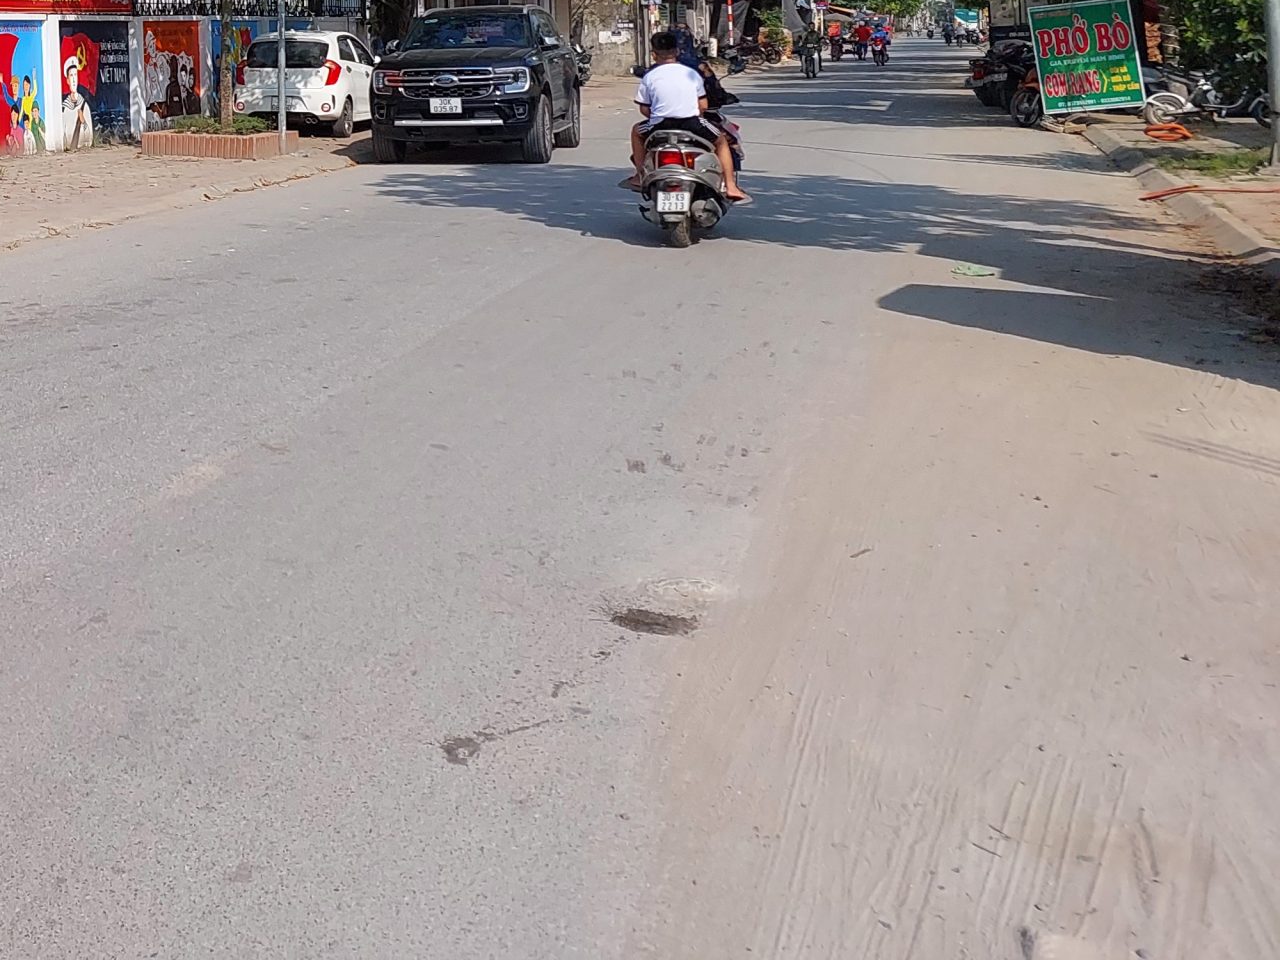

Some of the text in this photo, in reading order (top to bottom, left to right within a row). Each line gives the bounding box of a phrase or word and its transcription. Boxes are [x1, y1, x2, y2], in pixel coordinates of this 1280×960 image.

[1036, 12, 1131, 59] PHỞ BÒ
[100, 65, 127, 86] VIỆT NAM
[661, 202, 685, 211] 2213
